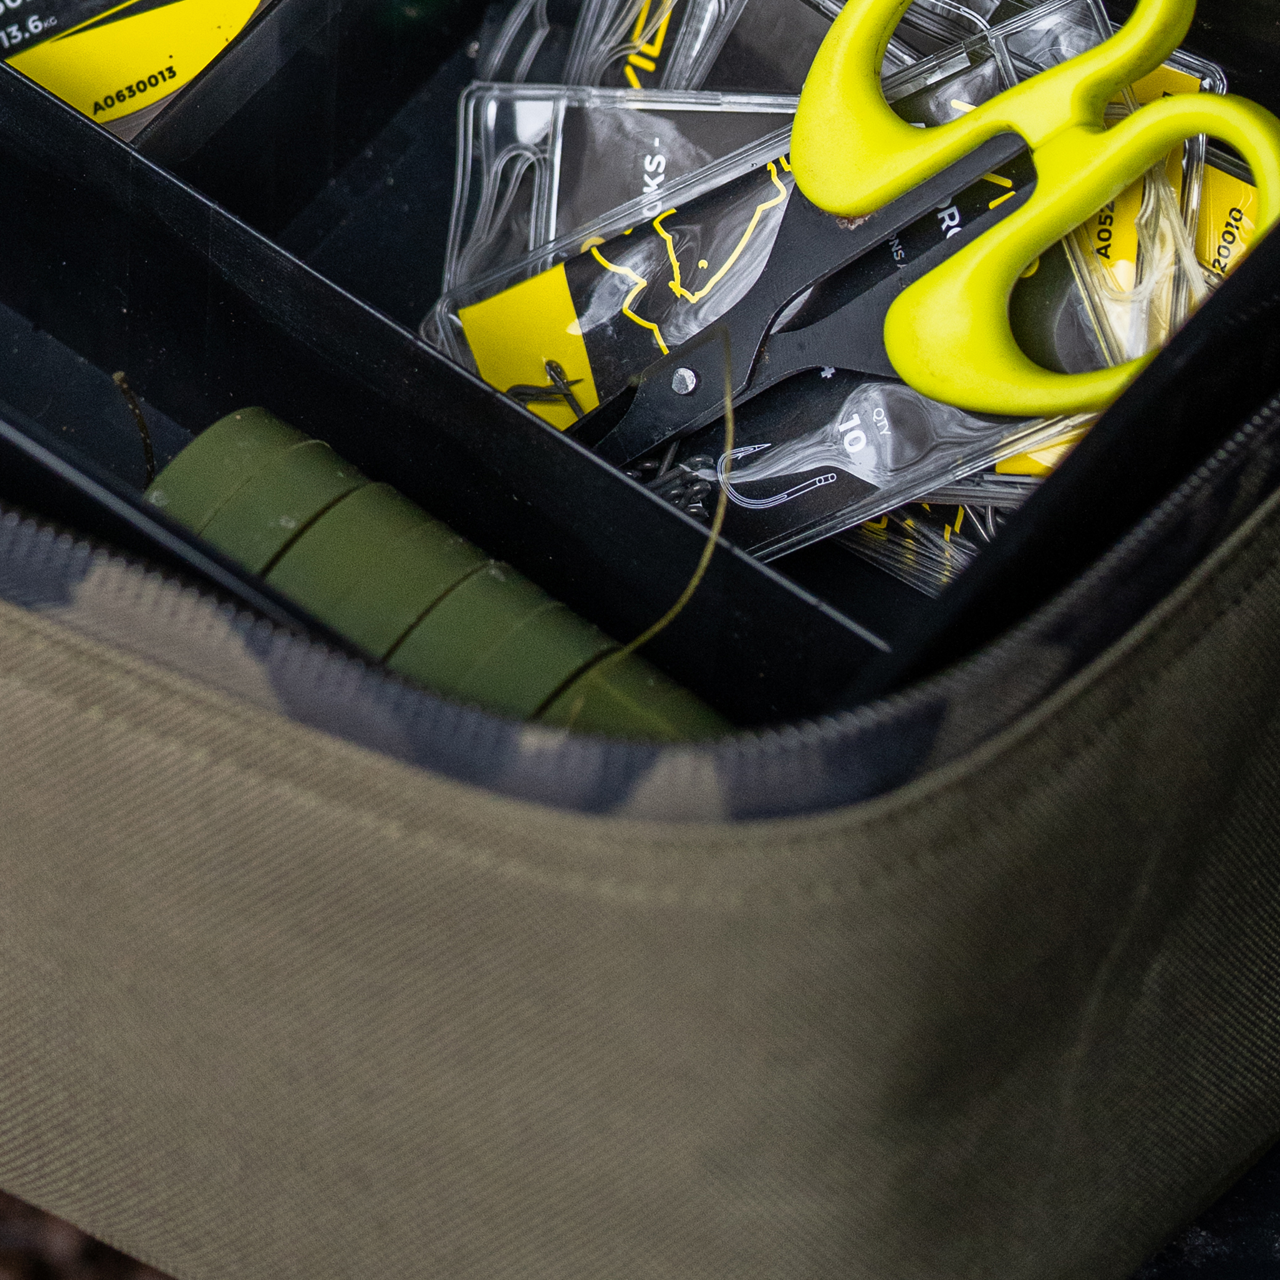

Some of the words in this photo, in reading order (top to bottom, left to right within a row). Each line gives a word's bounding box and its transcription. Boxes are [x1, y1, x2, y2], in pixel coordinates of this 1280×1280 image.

[92, 65, 178, 117] A0630013
[838, 413, 867, 453] 10
[872, 407, 892, 435] QTY
